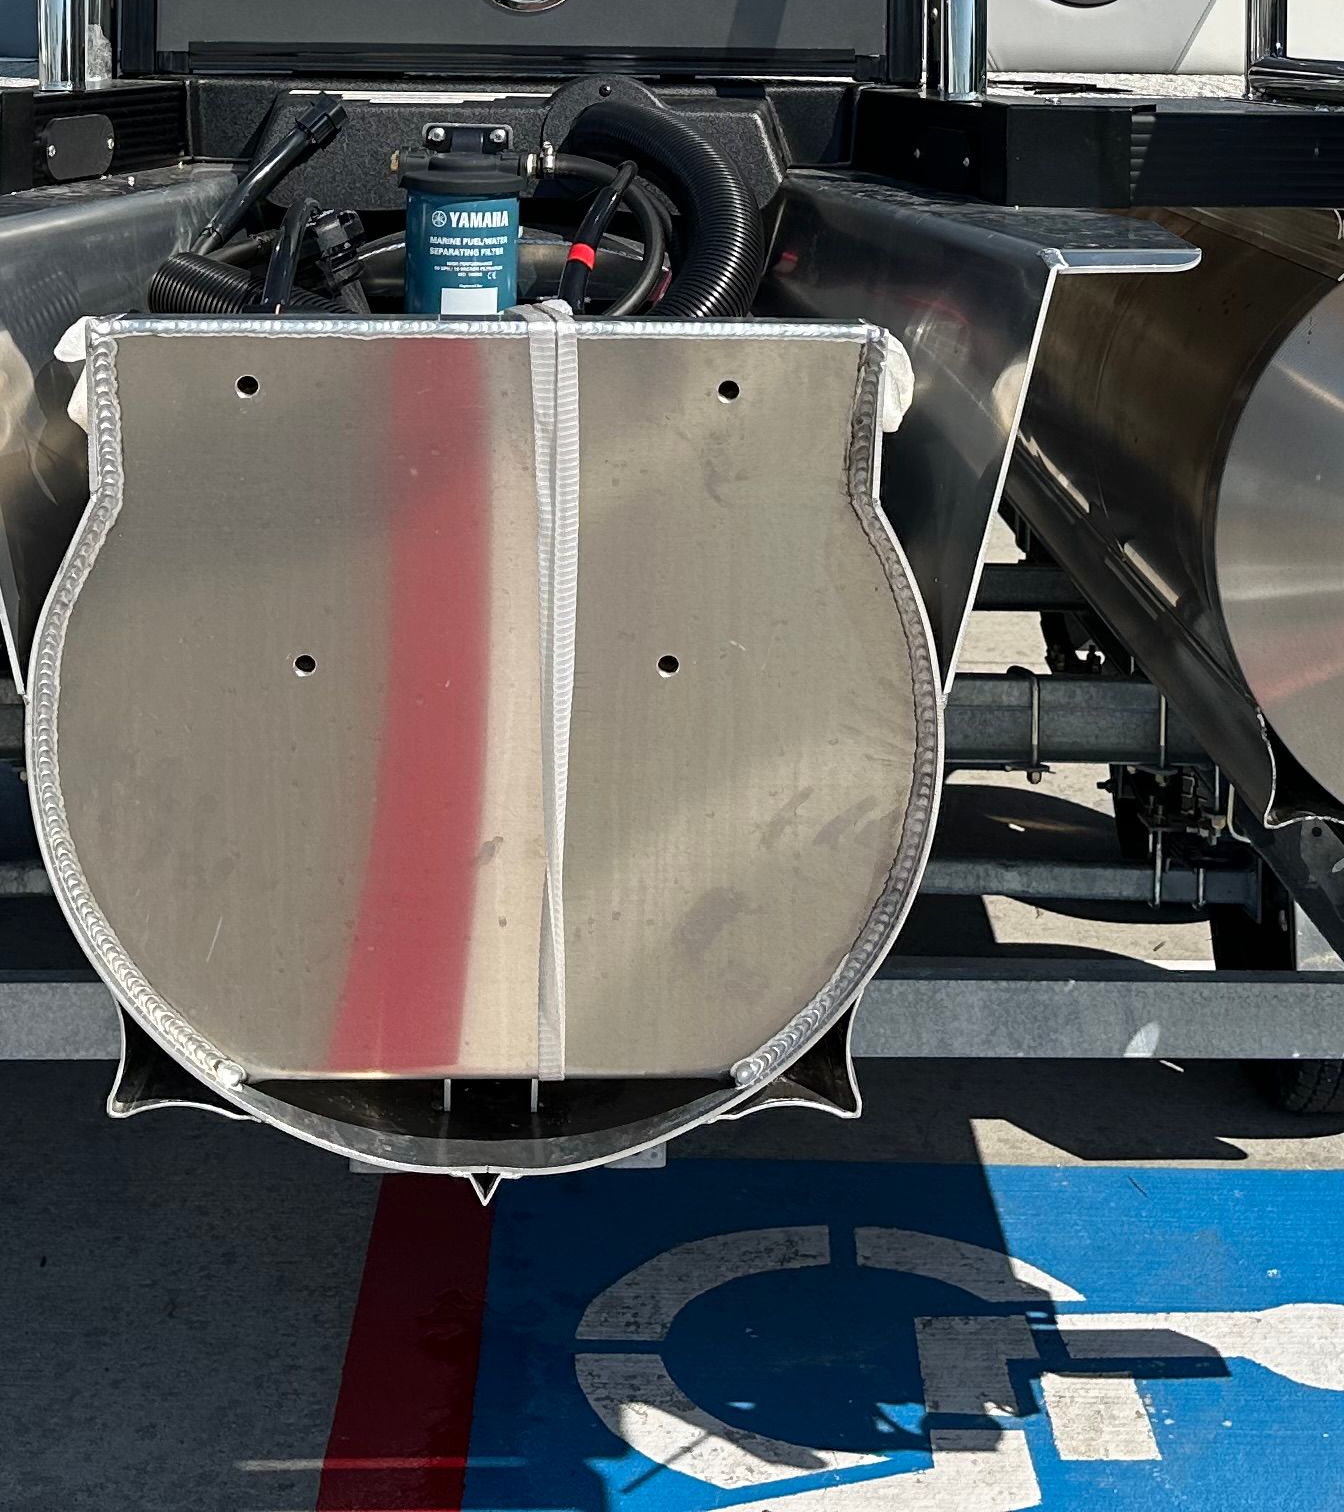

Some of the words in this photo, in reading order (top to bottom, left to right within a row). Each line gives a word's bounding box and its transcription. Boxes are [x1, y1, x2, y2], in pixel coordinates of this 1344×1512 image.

[449, 210, 509, 229] YAMAHA
[429, 236, 462, 246] MARINE
[429, 247, 480, 256] SEPARATING
[480, 247, 504, 256] FILTER
